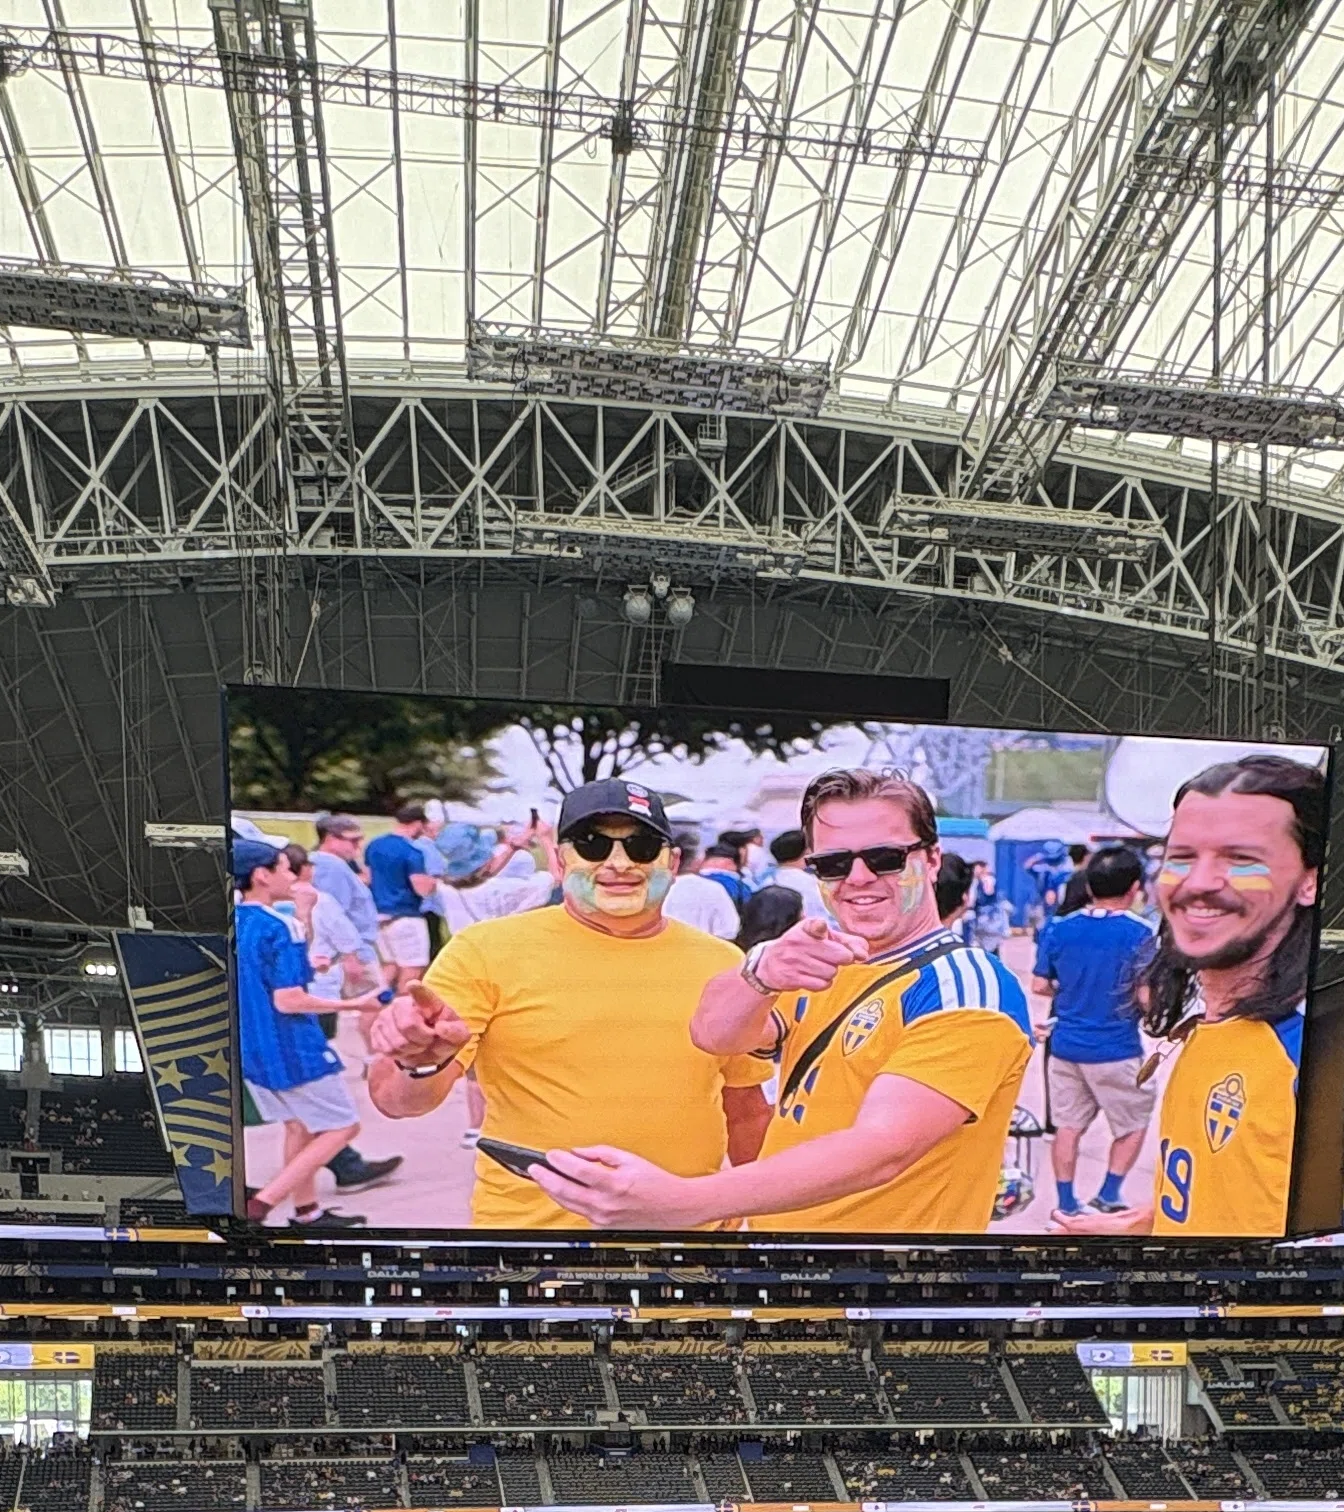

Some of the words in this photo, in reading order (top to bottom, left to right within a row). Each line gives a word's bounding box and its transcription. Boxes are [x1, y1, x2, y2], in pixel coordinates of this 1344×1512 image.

[367, 1269, 421, 1279] DALLAS
[781, 1272, 831, 1281] DALLAS
[1256, 1270, 1308, 1279] DALLAS
